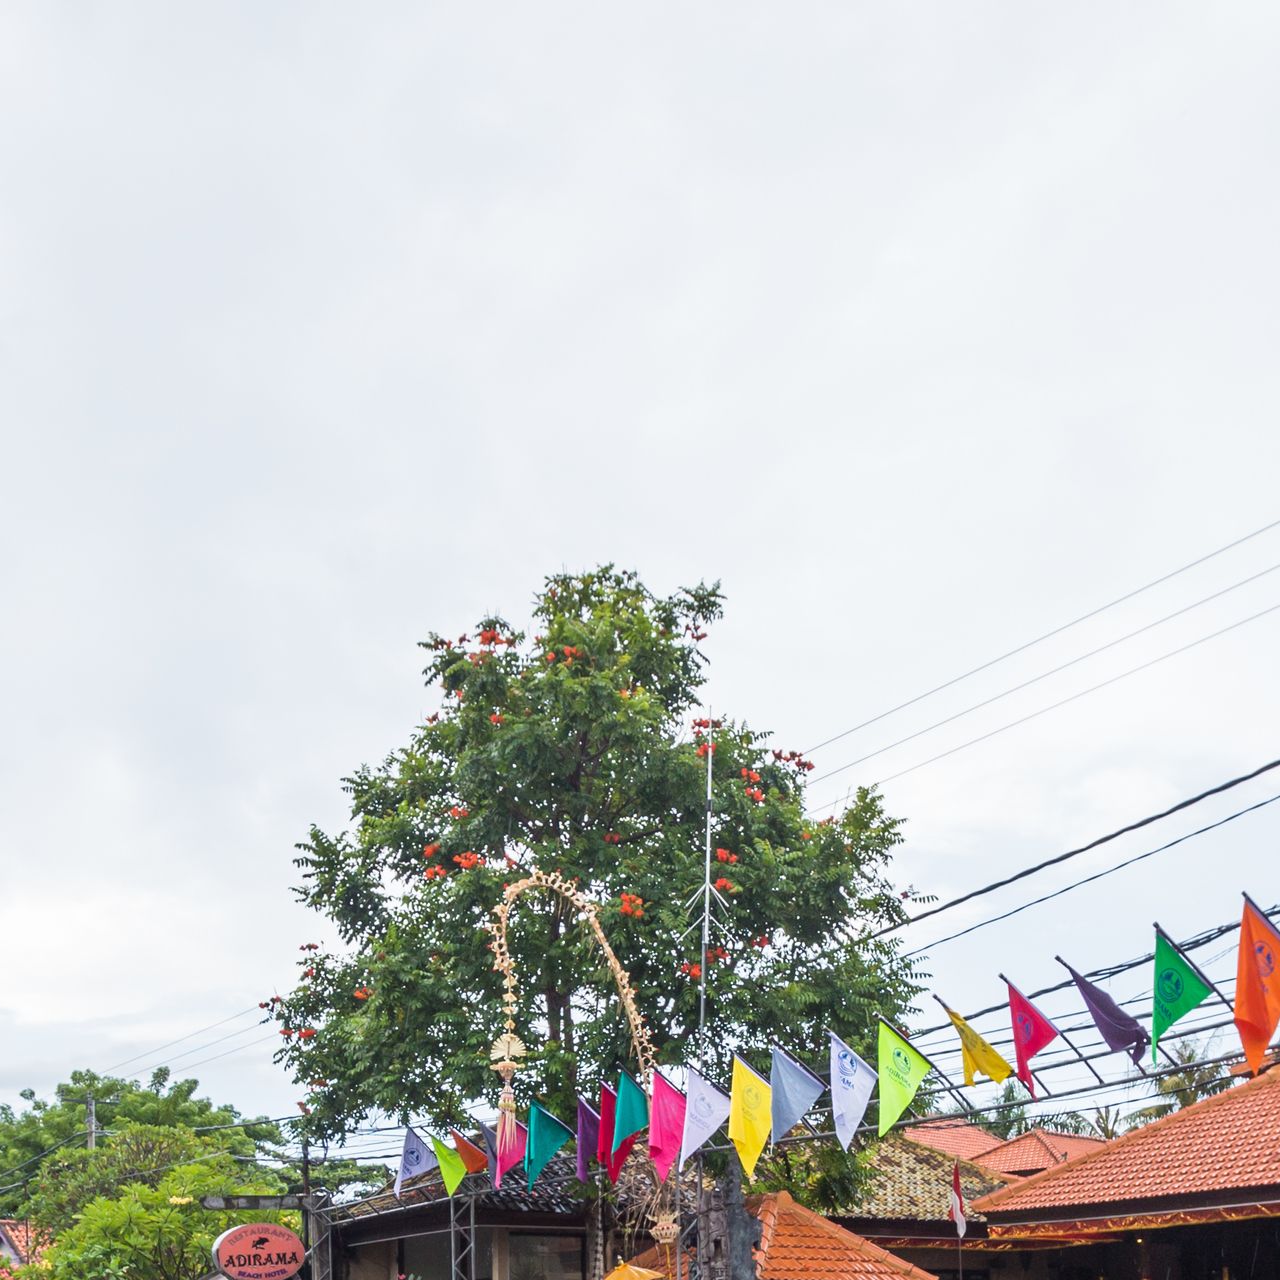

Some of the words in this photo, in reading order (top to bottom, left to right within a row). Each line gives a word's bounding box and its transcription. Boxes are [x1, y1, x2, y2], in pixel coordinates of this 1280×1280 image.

[228, 1227, 293, 1245] RESTAURANT
[224, 1251, 300, 1268] ADIRAMA
[237, 1270, 263, 1279] BEACH
[264, 1268, 288, 1278] HOTEL
